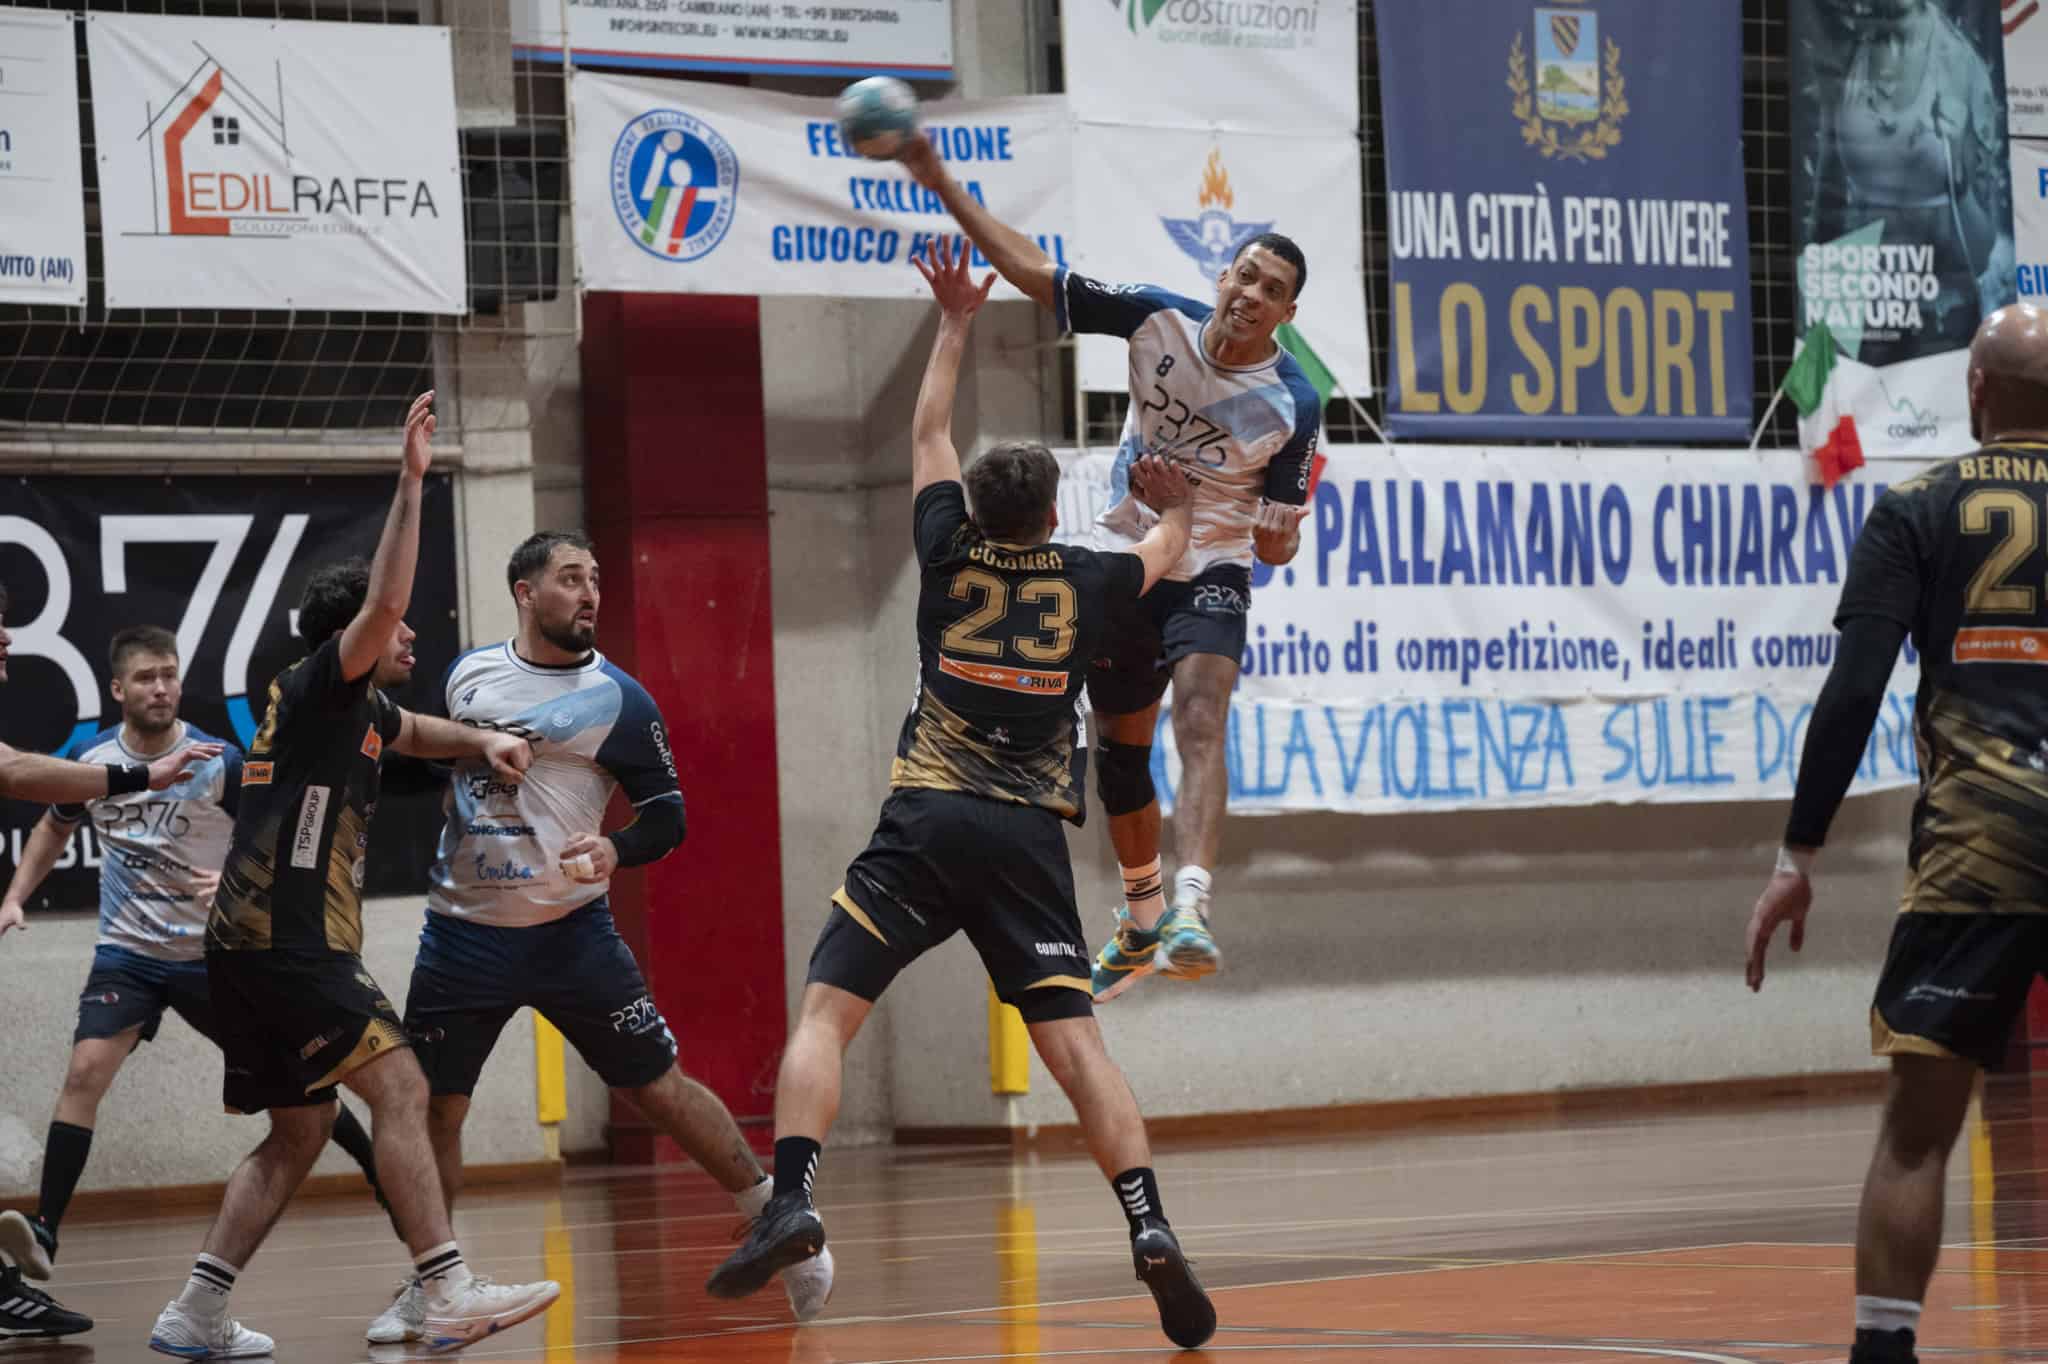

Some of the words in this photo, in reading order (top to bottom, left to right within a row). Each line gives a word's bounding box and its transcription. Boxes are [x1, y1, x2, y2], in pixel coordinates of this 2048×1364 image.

[1166, 0, 1319, 32] costruzioni
[1390, 190, 1462, 259] UNA
[1467, 183, 1557, 262] CITTÀ
[1563, 197, 1622, 264] PER
[1627, 200, 1732, 268] VIVERE
[773, 225, 898, 263] GIUOCO
[1804, 243, 1934, 272] SPORTIVI
[40, 257, 74, 284] (AN)
[1804, 272, 1939, 300] SECONDO
[1804, 300, 1923, 328] NATURA
[1156, 353, 1175, 378] 8
[1395, 283, 1486, 413] LO
[1510, 285, 1734, 416] SPORT
[1316, 479, 1632, 587] PALLAMANO
[940, 564, 1079, 664] 23
[1343, 621, 1378, 673] di
[1396, 622, 1630, 686] competizione,
[1643, 619, 1736, 670] ideali
[462, 687, 478, 706] 4
[1031, 675, 1063, 690] RIVA
[1324, 698, 1574, 800] VIOLENZA
[1601, 696, 1736, 789] SULLE
